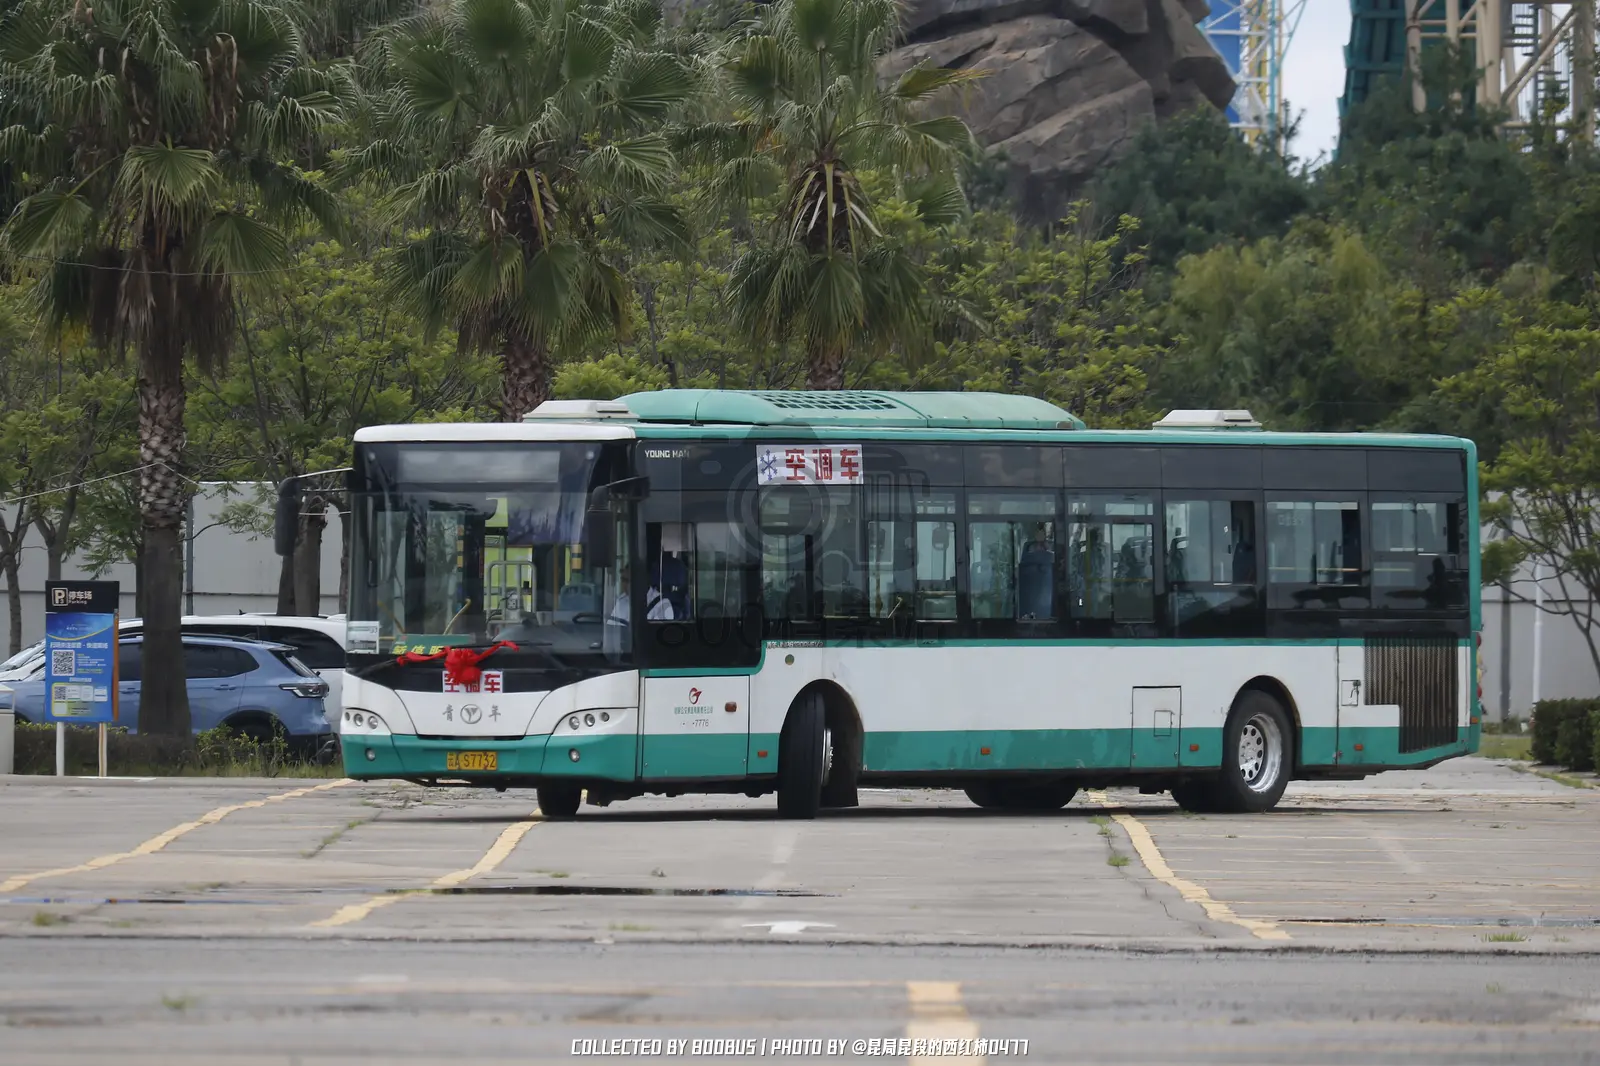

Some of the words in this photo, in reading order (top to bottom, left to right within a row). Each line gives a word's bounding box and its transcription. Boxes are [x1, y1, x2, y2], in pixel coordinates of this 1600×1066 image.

[645, 449, 670, 458] YOUNG
[785, 448, 859, 480] 空调车
[68, 590, 93, 600] 停车场
